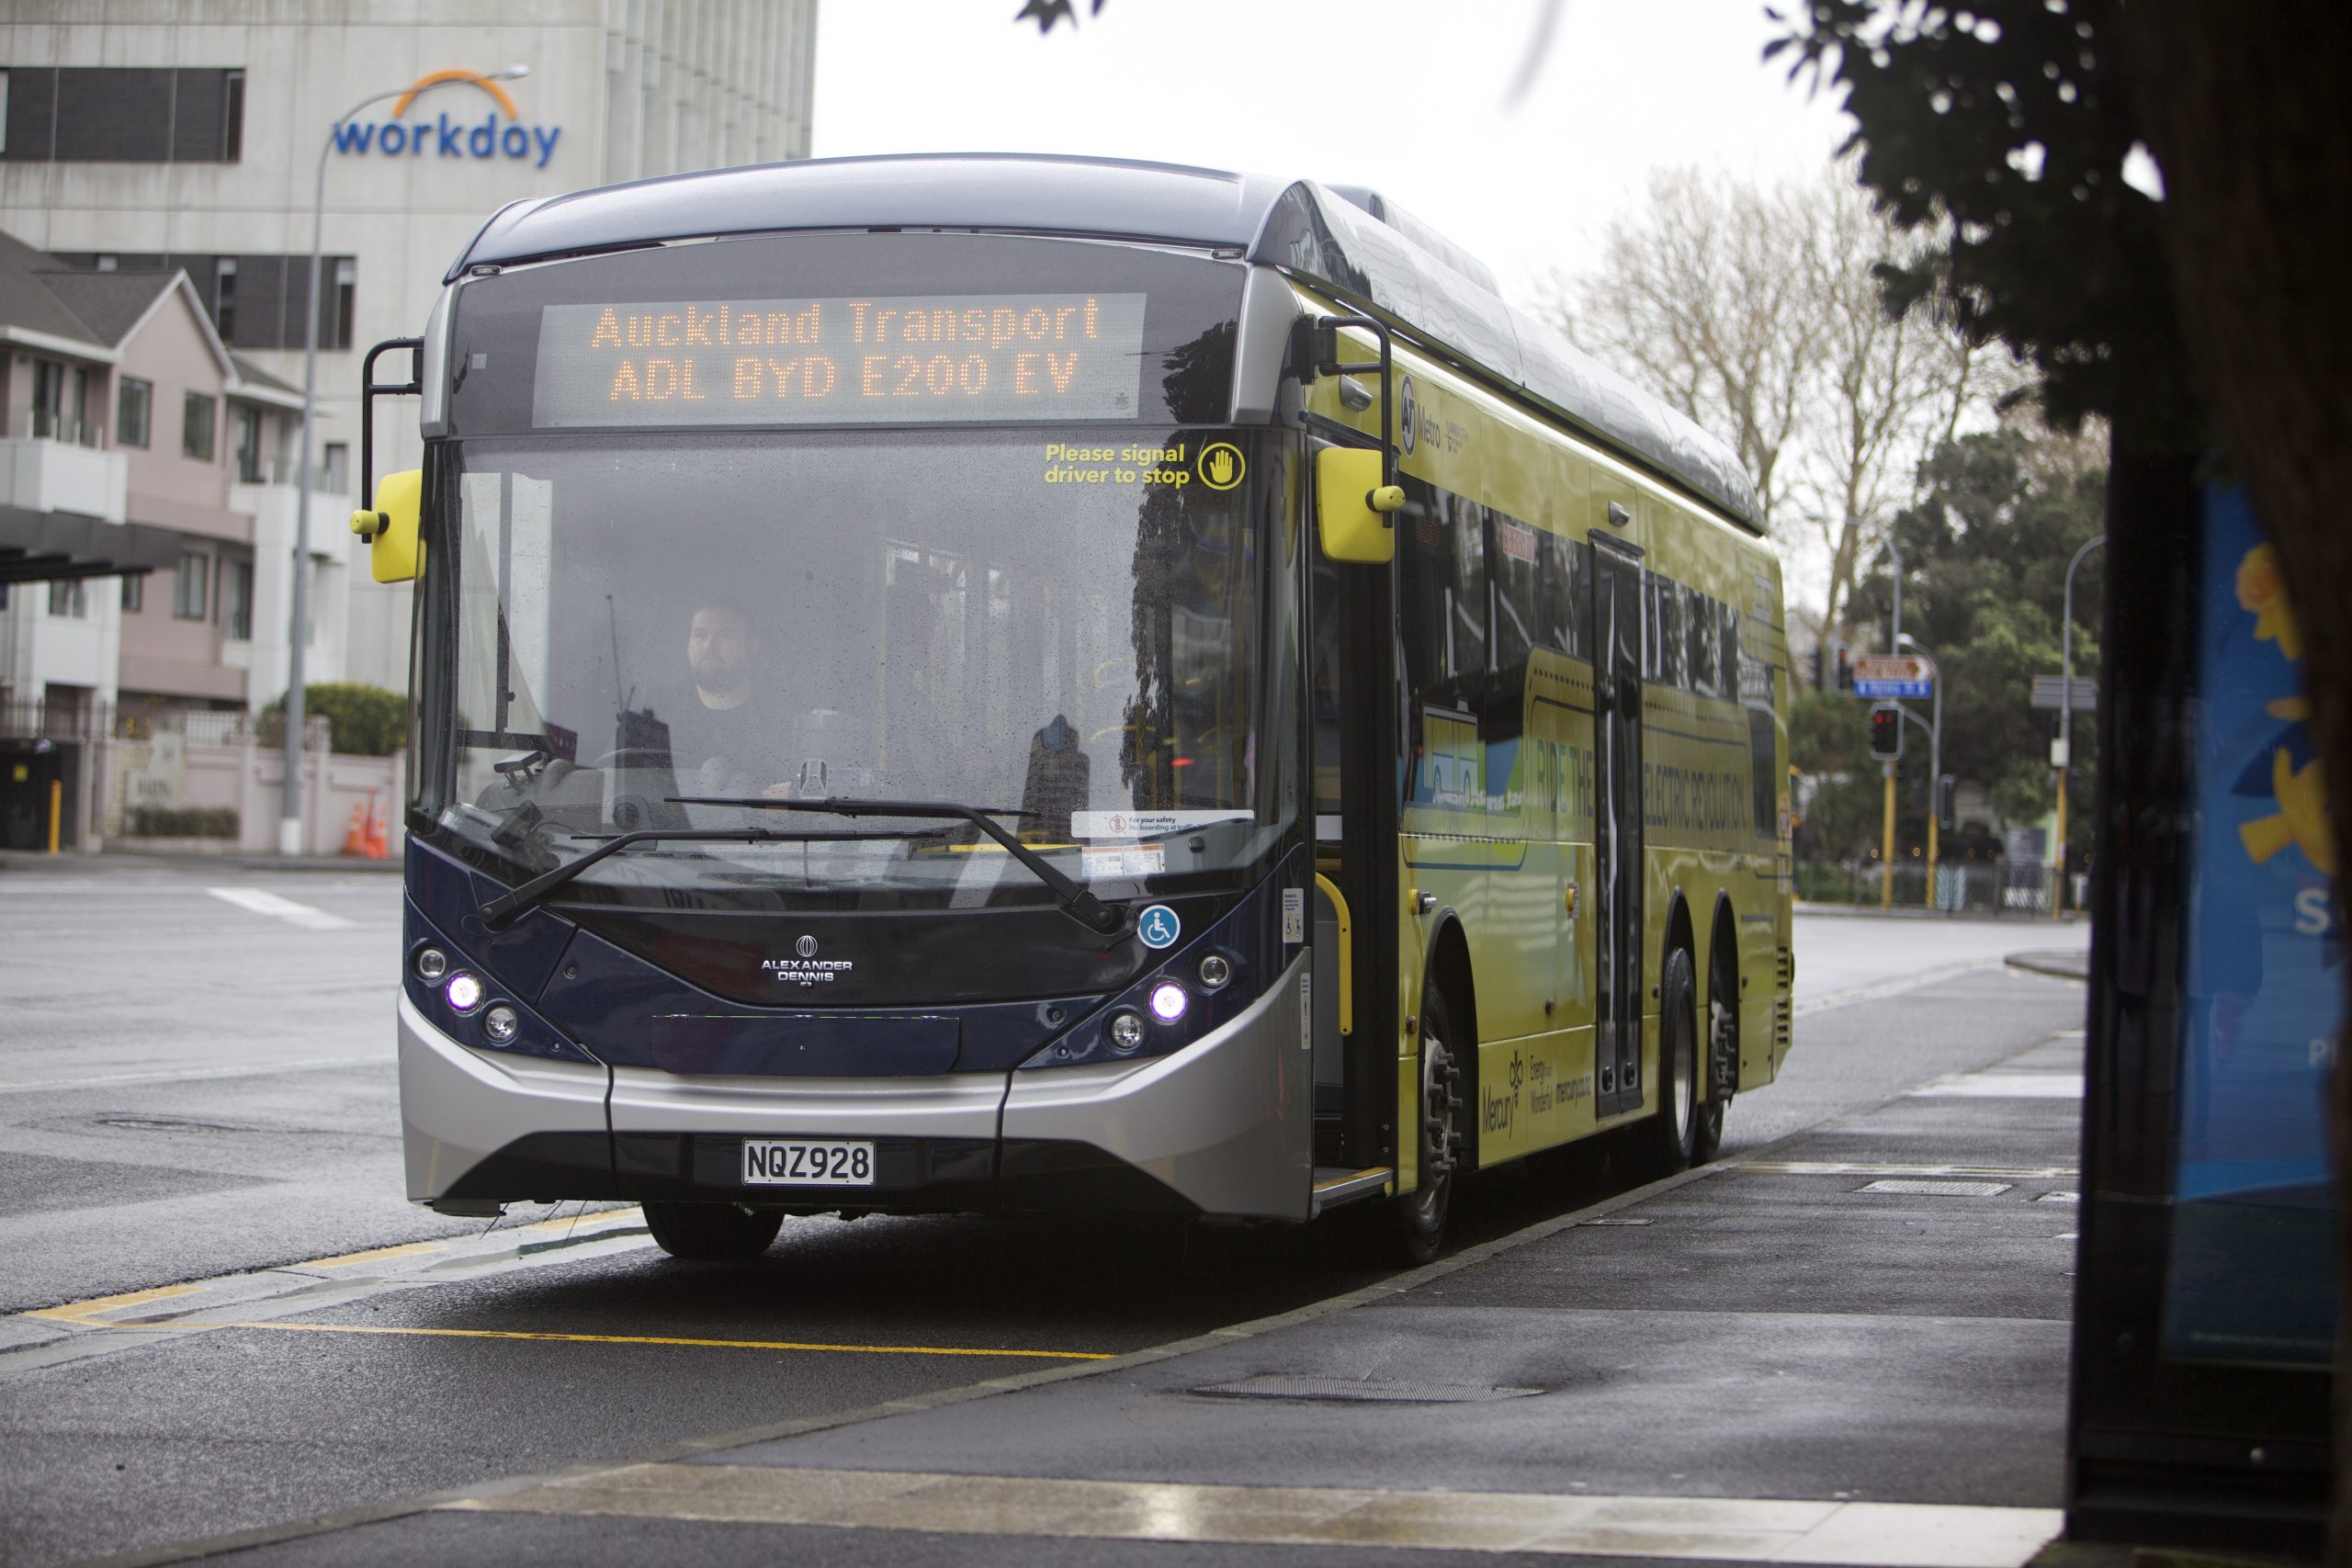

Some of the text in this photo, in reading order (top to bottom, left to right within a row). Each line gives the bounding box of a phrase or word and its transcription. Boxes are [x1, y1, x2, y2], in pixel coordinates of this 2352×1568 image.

[332, 111, 562, 168] workday
[591, 298, 1101, 349] Auckland Transport
[610, 352, 1078, 402] ADL BYD E200 EV
[1418, 403, 1441, 449] Metro
[1046, 443, 1185, 466] Please signal
[1044, 465, 1191, 489] driver to stop
[1569, 745, 1594, 818] THE
[761, 960, 854, 971] ALEXANDER
[777, 971, 834, 982] DENNIS
[1530, 1055, 1545, 1085] Energy
[1482, 1083, 1514, 1140] Mercury
[747, 1145, 870, 1179] NQZ928
